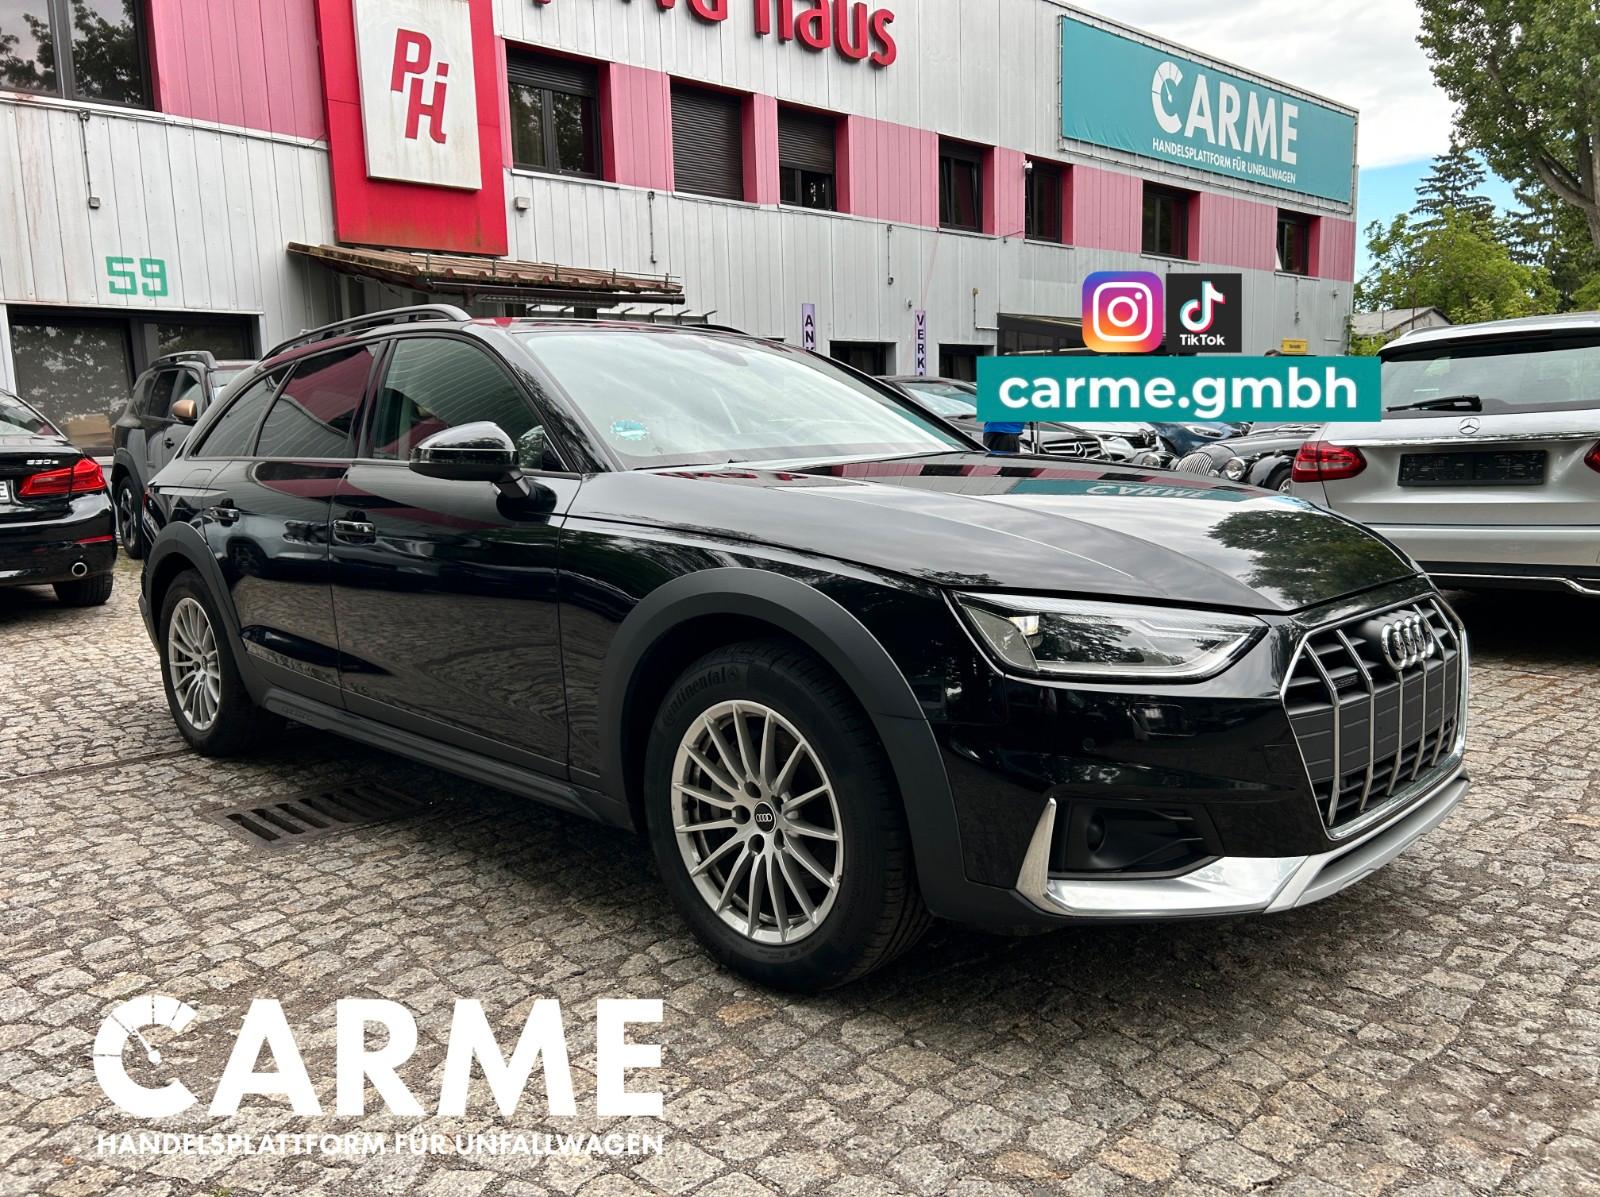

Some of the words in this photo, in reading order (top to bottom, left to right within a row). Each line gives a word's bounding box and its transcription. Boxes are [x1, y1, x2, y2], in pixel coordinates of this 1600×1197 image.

[1151, 61, 1299, 165] CARME
[1152, 138, 1231, 168] HANDELSPLATTFORM
[1232, 156, 1247, 172] FÜR
[1247, 162, 1296, 184] UNFALLWAGEN
[105, 256, 168, 297] 59
